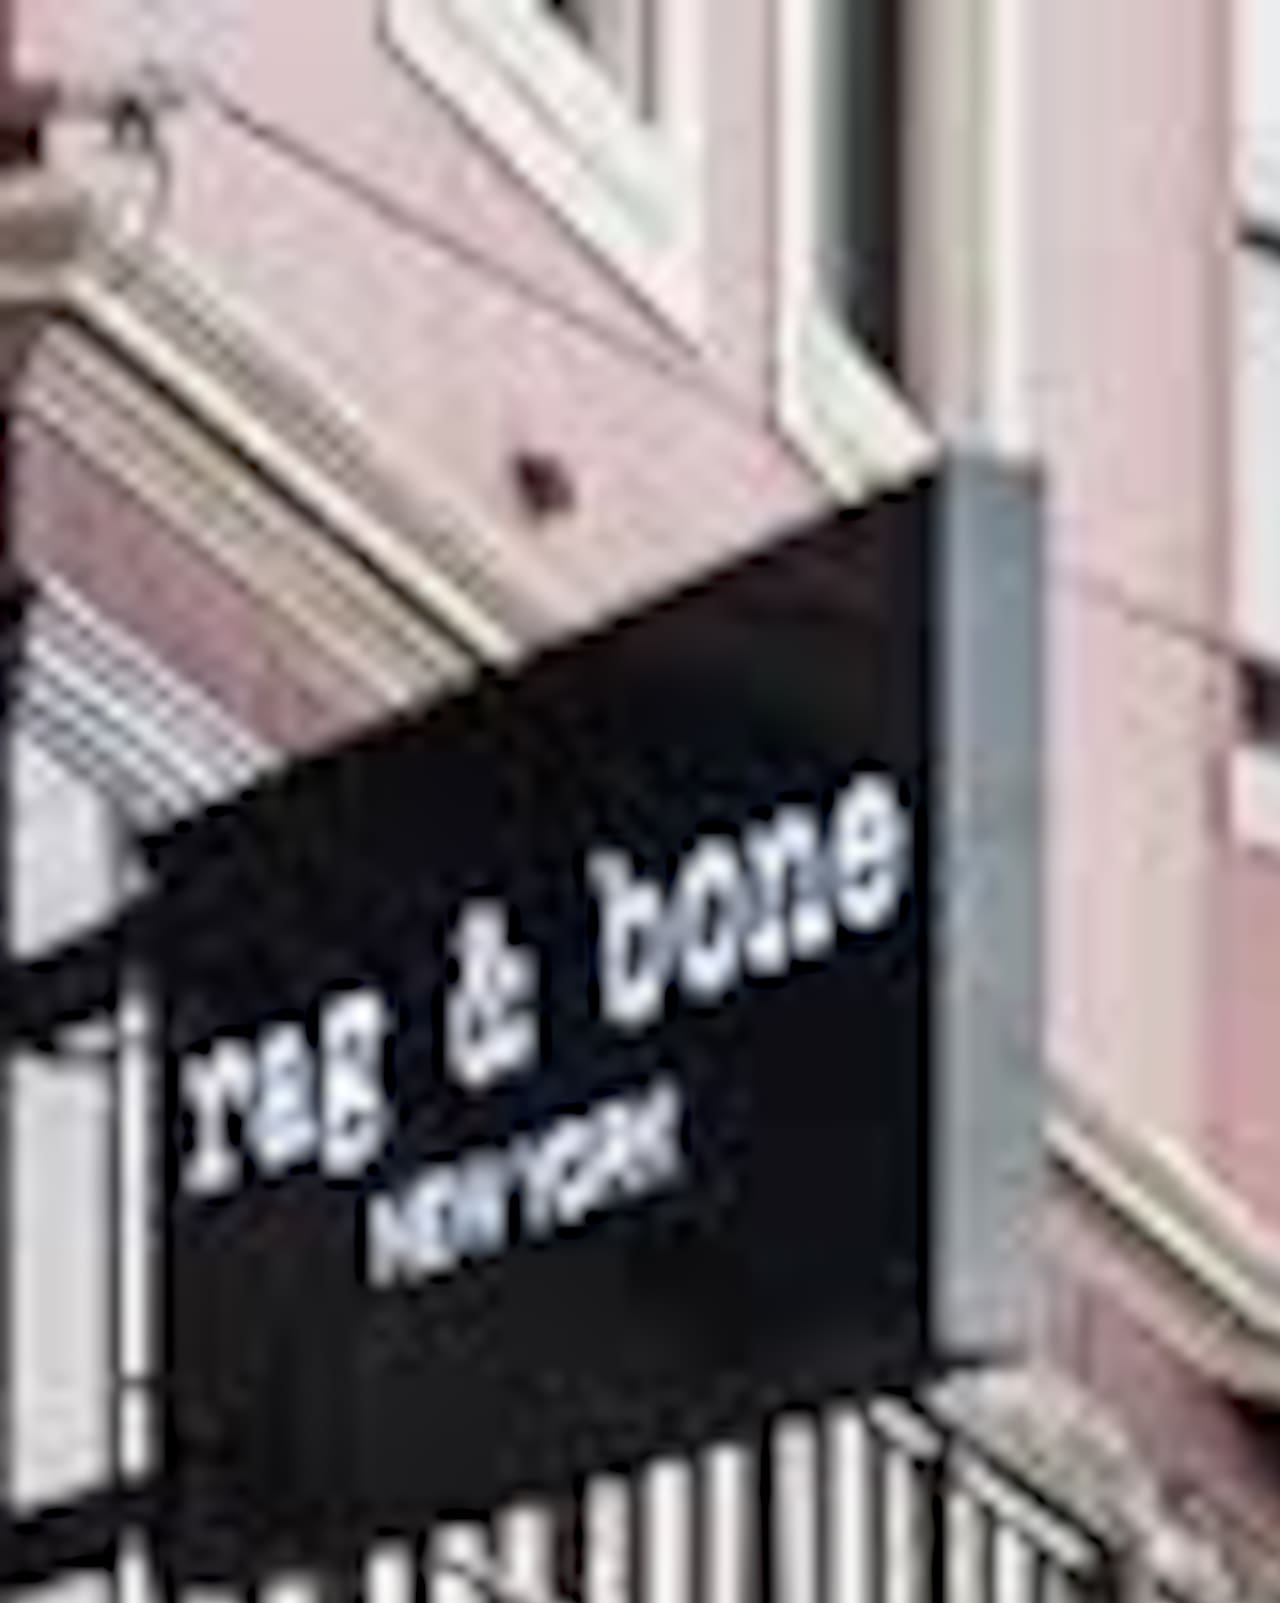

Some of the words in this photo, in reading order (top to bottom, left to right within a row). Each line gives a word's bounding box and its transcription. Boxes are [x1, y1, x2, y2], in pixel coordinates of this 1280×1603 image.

[182, 989, 388, 1193] rag
[446, 902, 537, 1088] &
[590, 774, 906, 1027] bone
[367, 1152, 507, 1288] NEW
[512, 1078, 680, 1242] YORK
